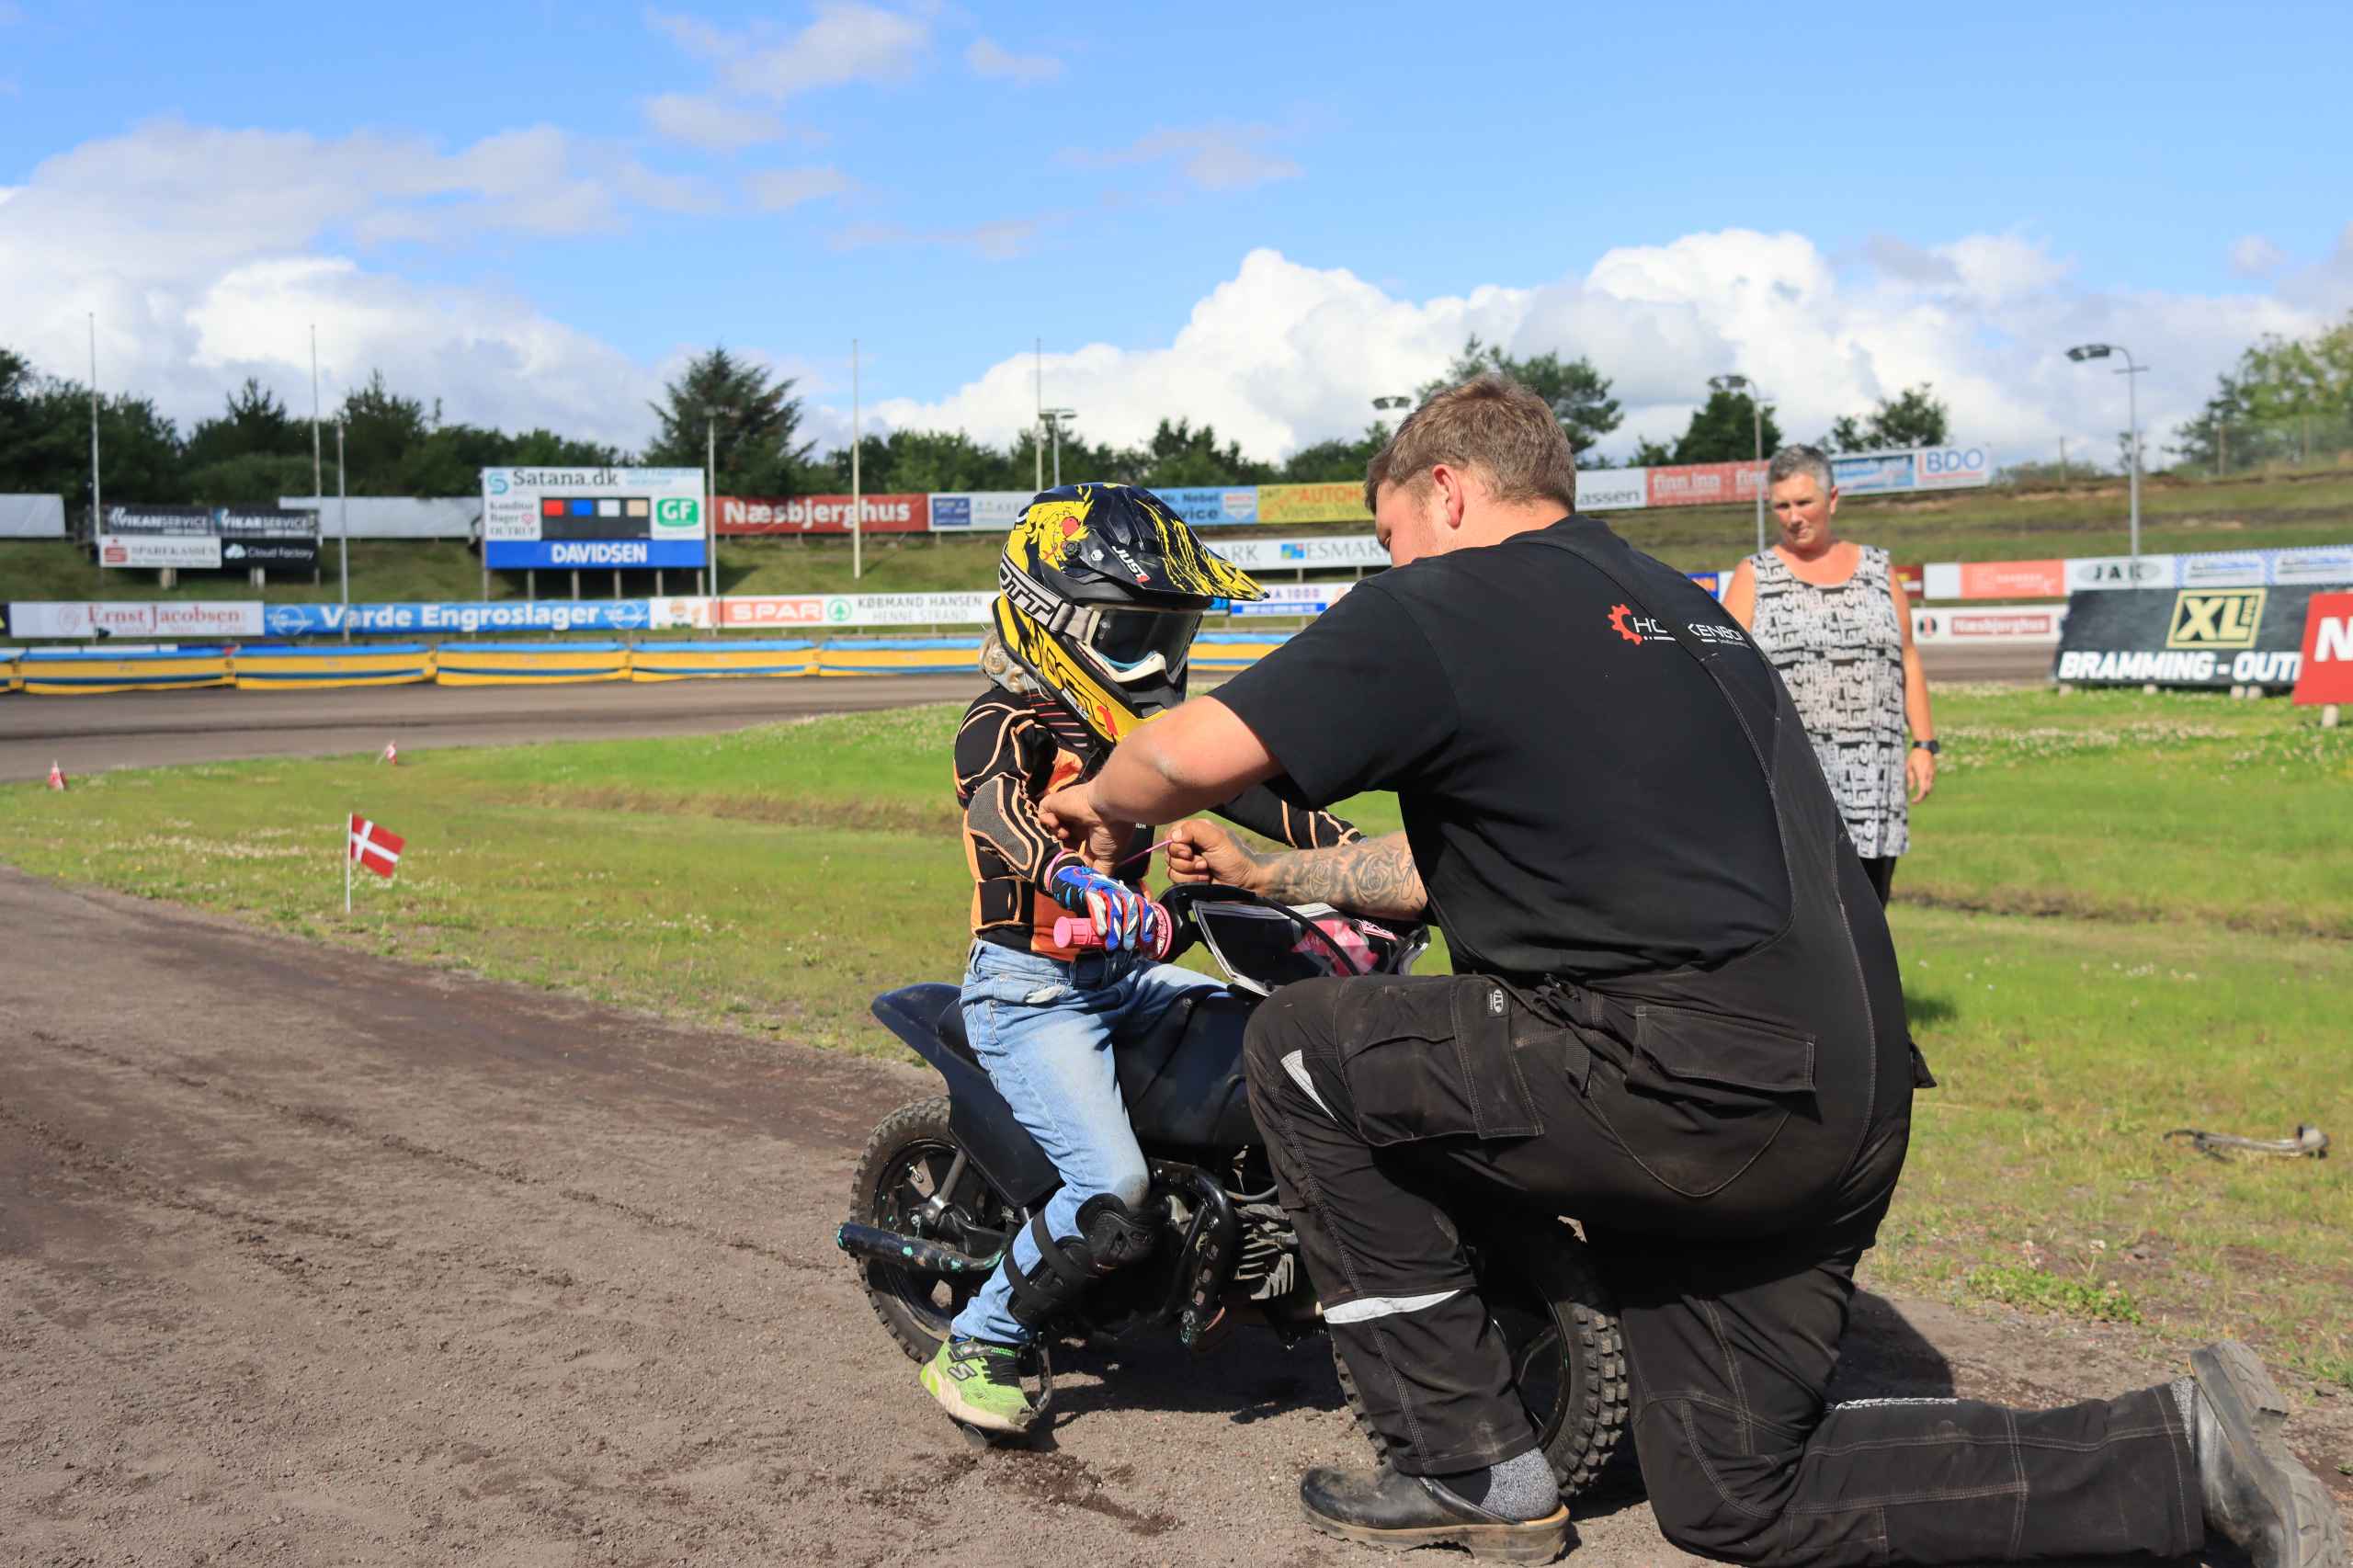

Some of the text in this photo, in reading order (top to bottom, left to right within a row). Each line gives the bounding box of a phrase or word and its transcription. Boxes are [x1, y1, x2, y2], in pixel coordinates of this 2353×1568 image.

[1927, 448, 1984, 473] BDO
[513, 469, 619, 487] Satana.dk
[1576, 491, 1640, 505] assen
[662, 499, 693, 520] GF
[723, 498, 911, 529] Næsbjerghus
[551, 542, 648, 564] DAVIDSEN
[1307, 541, 1390, 560] ESMAR
[731, 602, 822, 622] SPAR
[929, 596, 983, 607] HANSEN
[87, 604, 146, 623] Ernst
[151, 604, 241, 632] Jacobsen
[320, 604, 413, 628] Varde
[420, 603, 600, 631] Engroslager
[2175, 597, 2251, 641] XL
